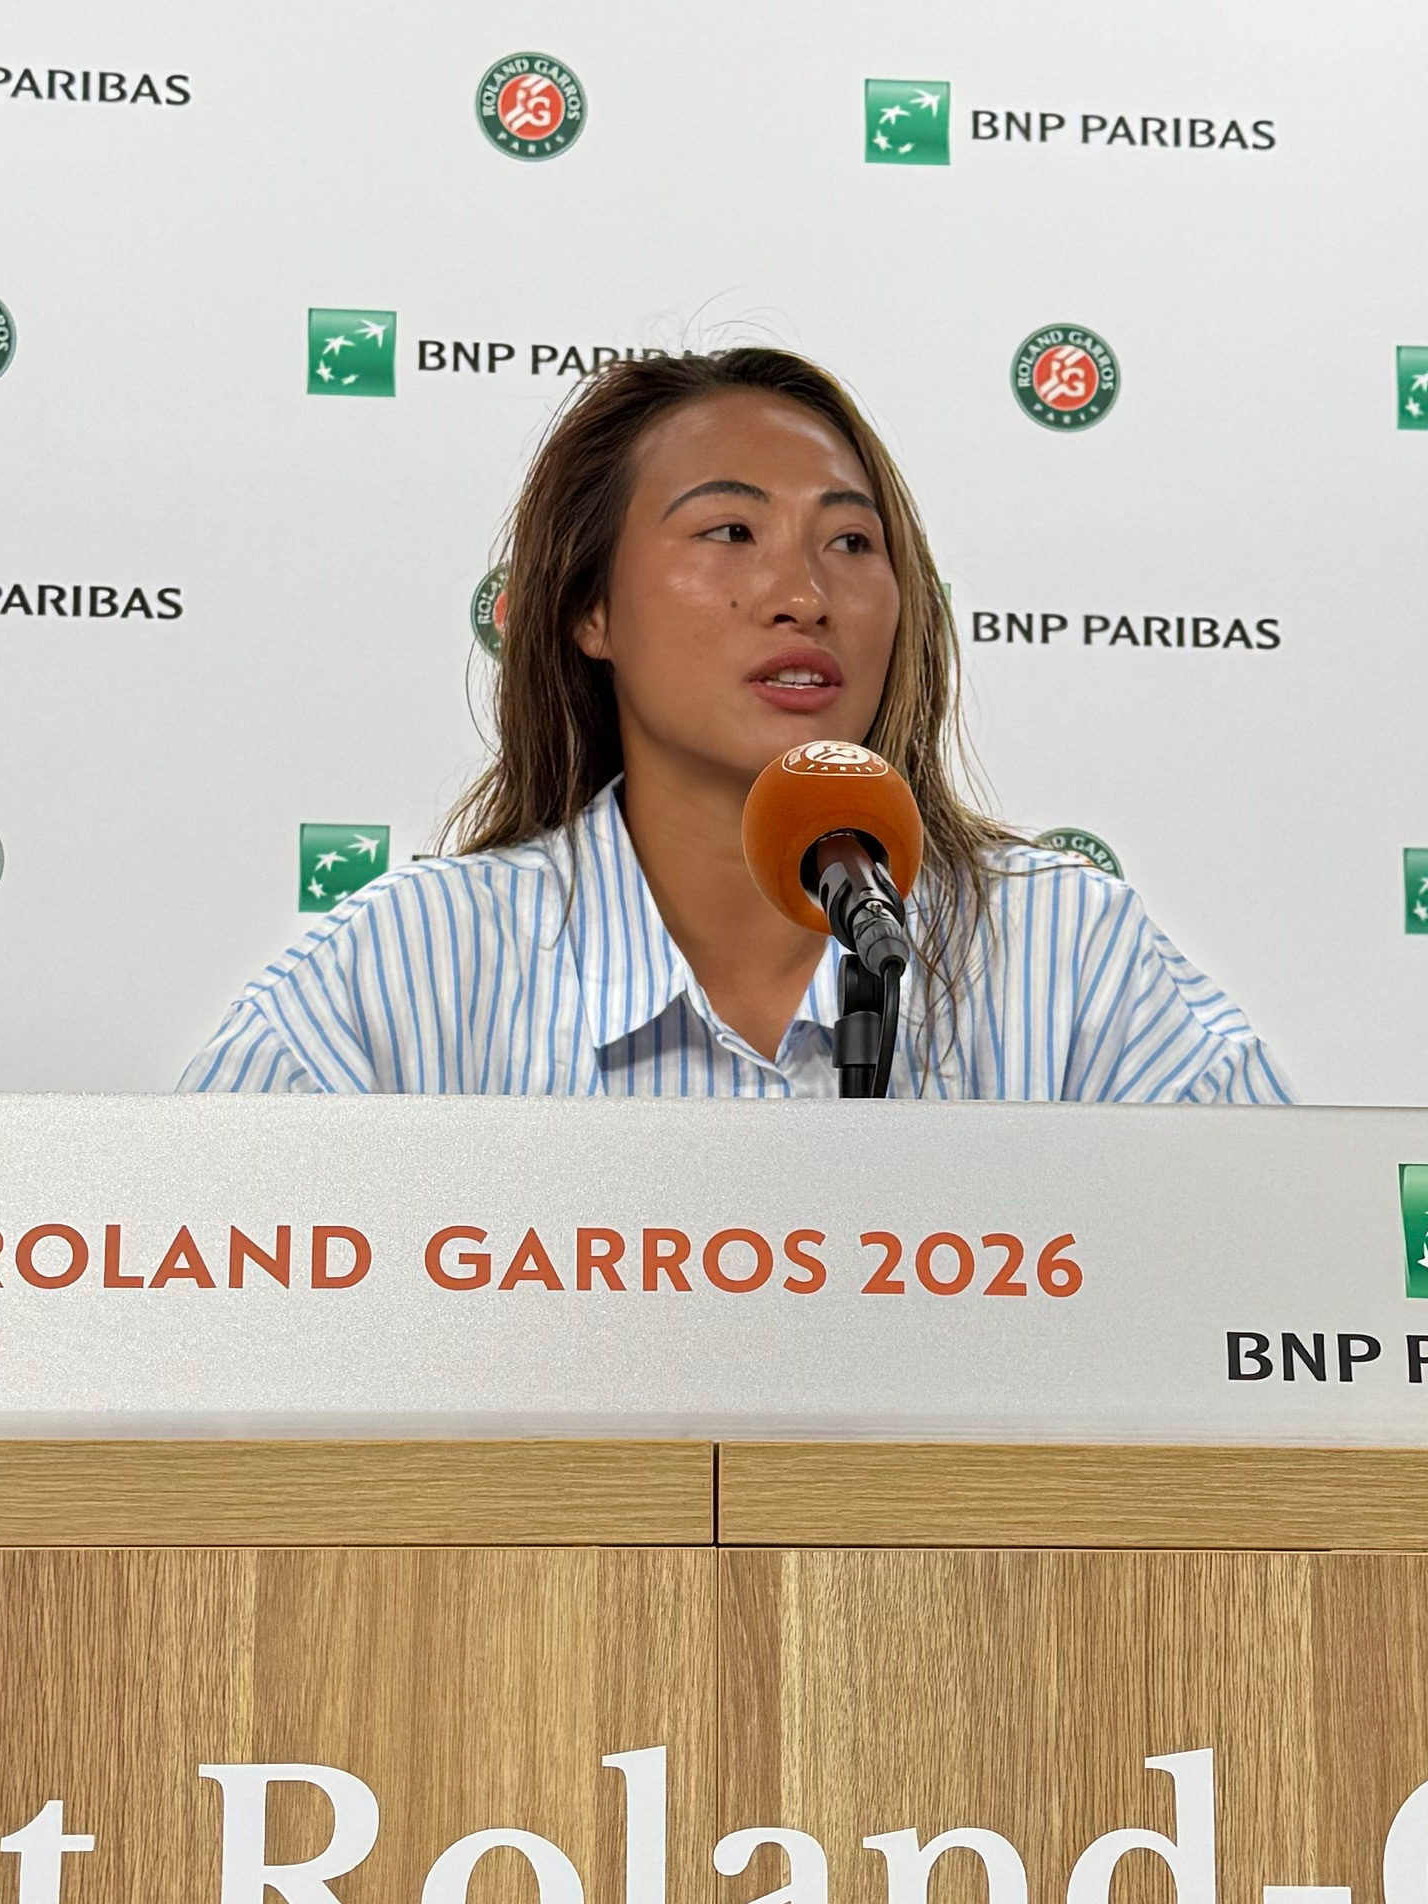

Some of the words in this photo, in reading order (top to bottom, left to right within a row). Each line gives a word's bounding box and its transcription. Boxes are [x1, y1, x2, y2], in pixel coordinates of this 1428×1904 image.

[481, 58, 529, 117] ROLAND
[534, 59, 581, 120] GARROS
[972, 110, 1066, 142] BNP
[1081, 114, 1276, 150] PARIBAS
[418, 340, 515, 374] BNP
[1017, 329, 1063, 388] ROLAND
[1068, 330, 1115, 391] GARROS
[972, 611, 1068, 644] BNP
[1083, 614, 1281, 650] PARIBAS
[423, 1224, 828, 1294] GARROS
[859, 1230, 1084, 1299] 2026
[1226, 1331, 1382, 1383] BNP
